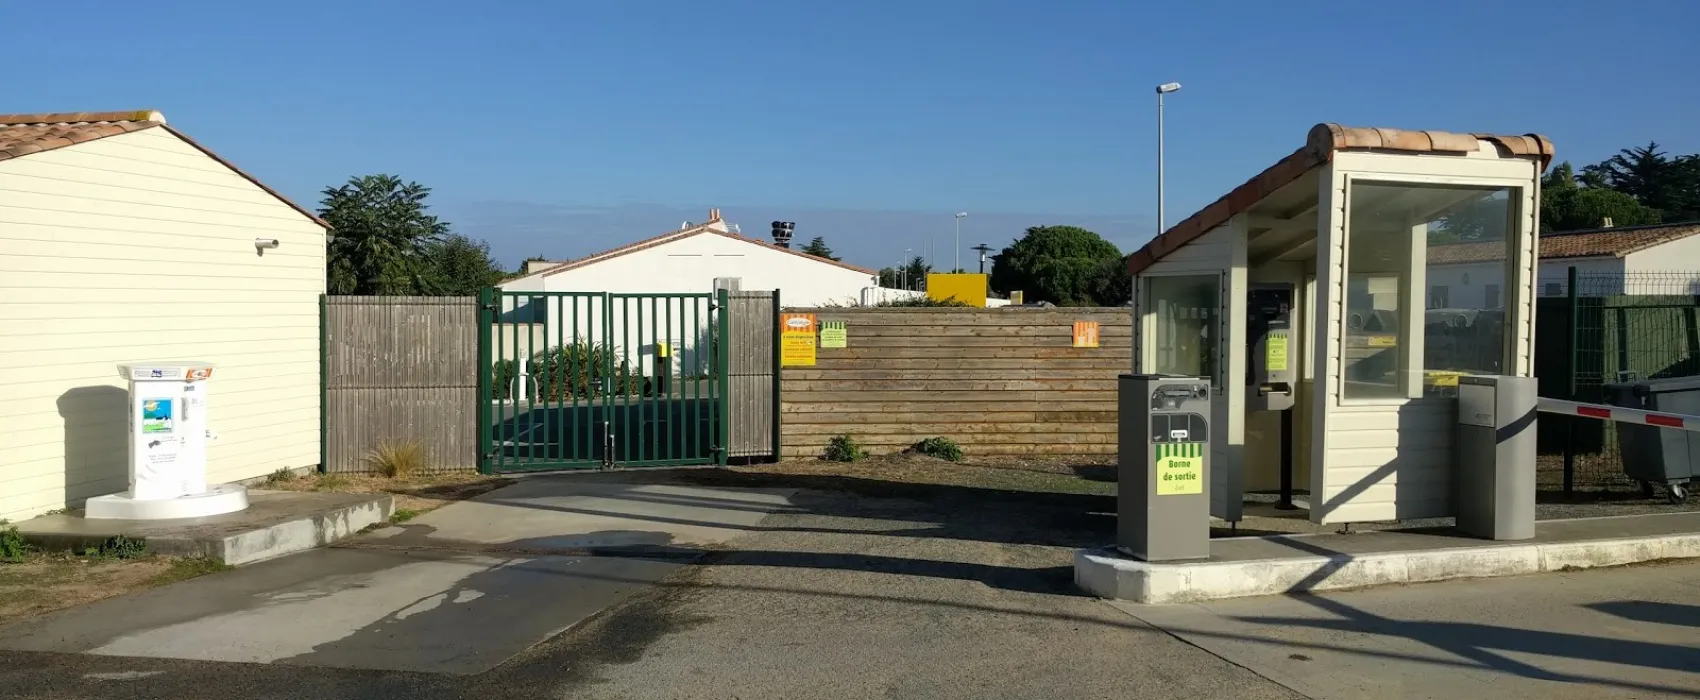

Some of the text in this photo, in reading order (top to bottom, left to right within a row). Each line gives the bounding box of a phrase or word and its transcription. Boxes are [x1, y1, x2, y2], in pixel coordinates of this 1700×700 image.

[1168, 459, 1191, 468] Borne
[1163, 471, 1196, 481] de sortie
